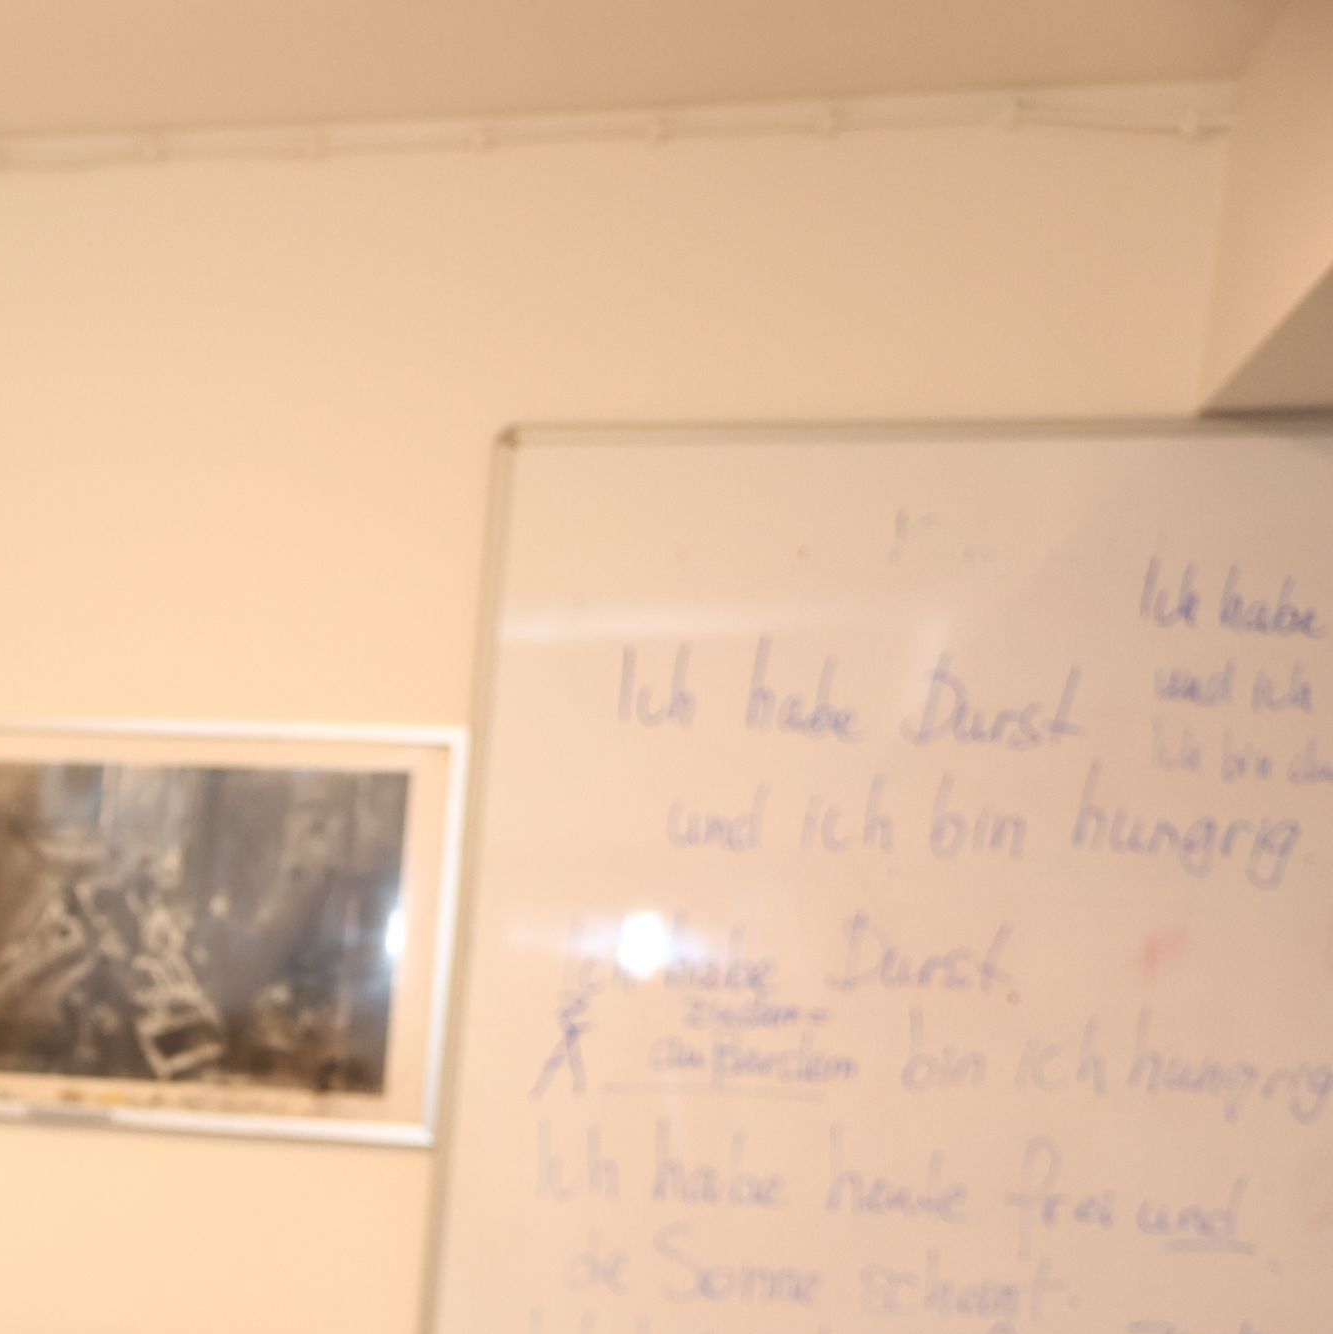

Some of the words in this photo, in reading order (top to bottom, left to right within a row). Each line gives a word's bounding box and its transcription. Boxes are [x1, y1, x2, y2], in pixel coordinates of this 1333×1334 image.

[1137, 552, 1201, 629] Ich
[1219, 560, 1327, 640] habe
[617, 643, 698, 731] Ich
[744, 631, 867, 746] habe
[898, 649, 1087, 752] Durst
[665, 780, 771, 856] und
[798, 772, 895, 856] ich
[928, 770, 1028, 863] bin
[900, 1006, 988, 1094] bin
[534, 1116, 621, 1204] Ich
[650, 1116, 789, 1209] habe
[1003, 1134, 1117, 1264] frei
